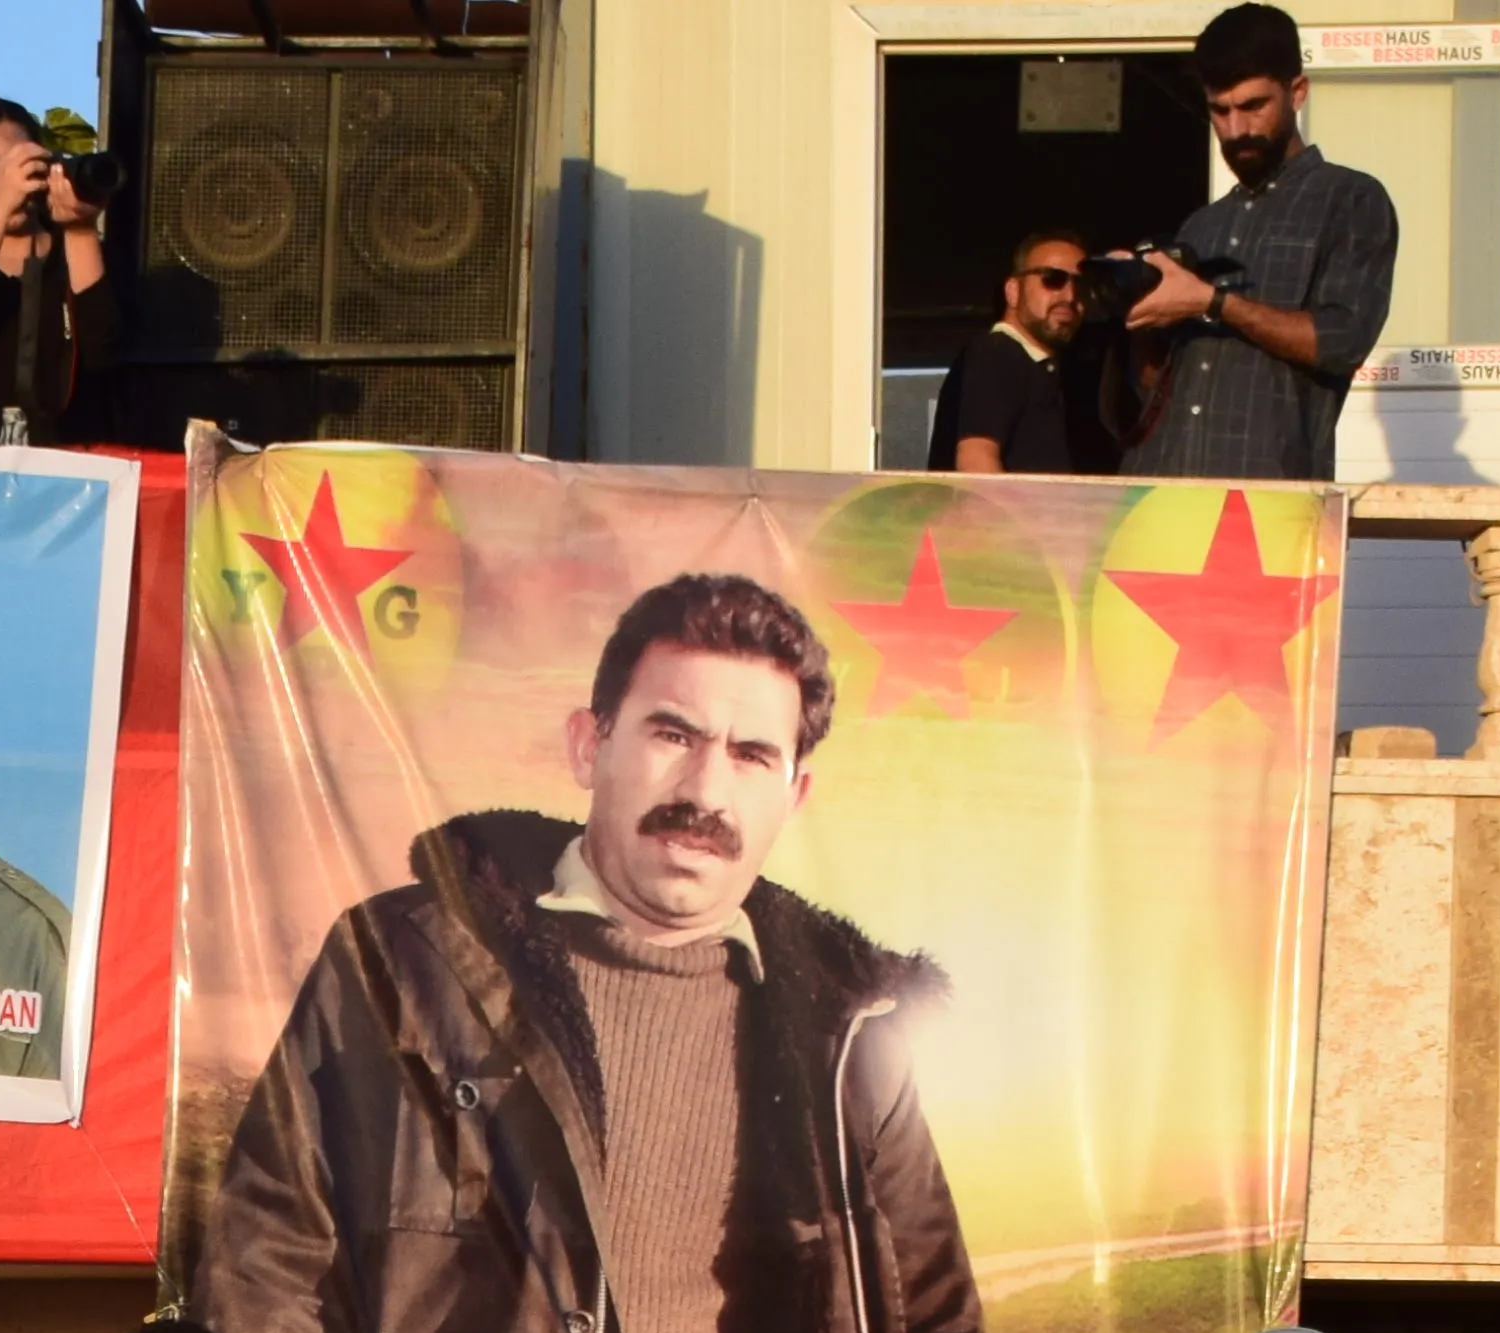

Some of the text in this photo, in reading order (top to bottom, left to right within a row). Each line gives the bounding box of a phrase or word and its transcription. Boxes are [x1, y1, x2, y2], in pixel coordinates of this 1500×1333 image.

[1321, 31, 1431, 47] BESSERHAUS
[1373, 47, 1483, 63] BESSERHAUS
[374, 585, 420, 640] G
